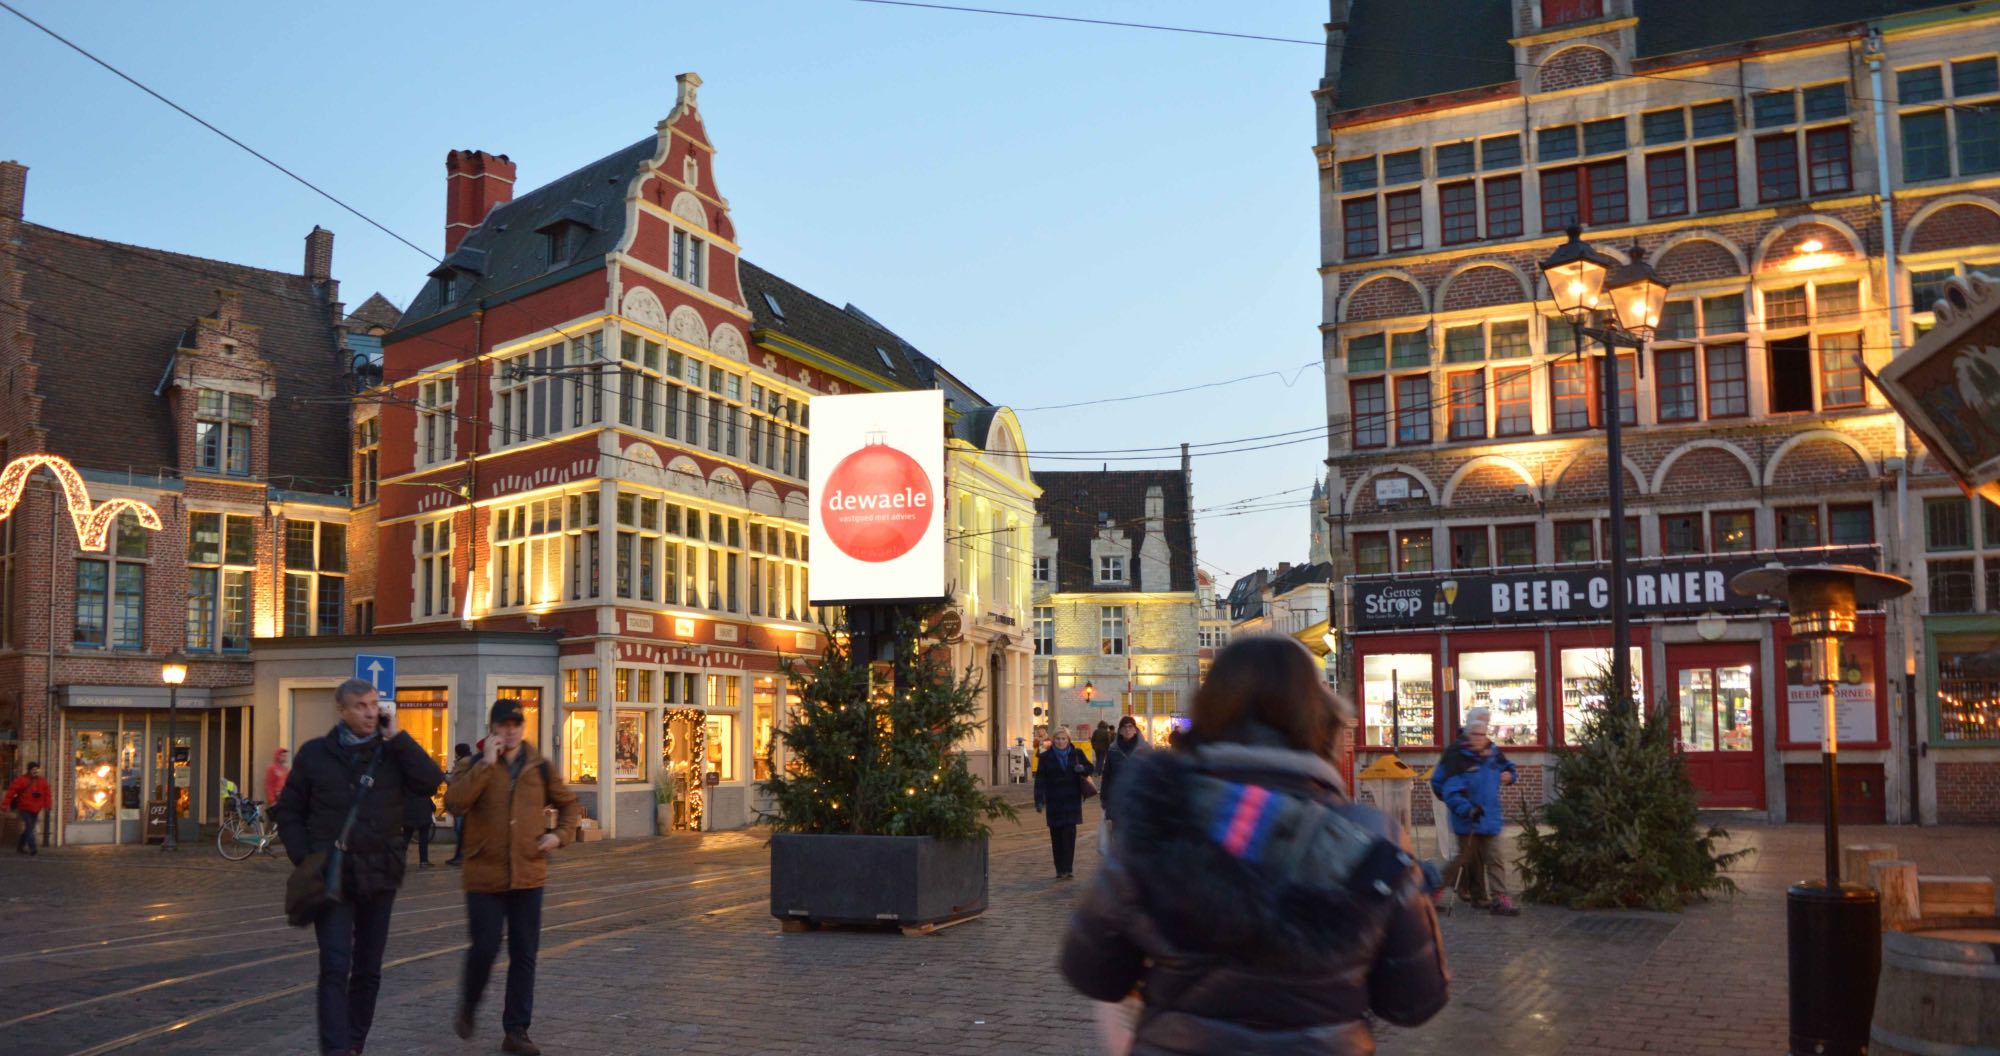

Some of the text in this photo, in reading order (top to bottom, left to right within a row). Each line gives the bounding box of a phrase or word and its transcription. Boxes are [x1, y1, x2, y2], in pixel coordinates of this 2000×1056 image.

[829, 487, 927, 511] dewaele
[1383, 586, 1422, 598] Gentse
[1491, 570, 1726, 613] BEER-CRNER
[1365, 594, 1423, 617] Strop
